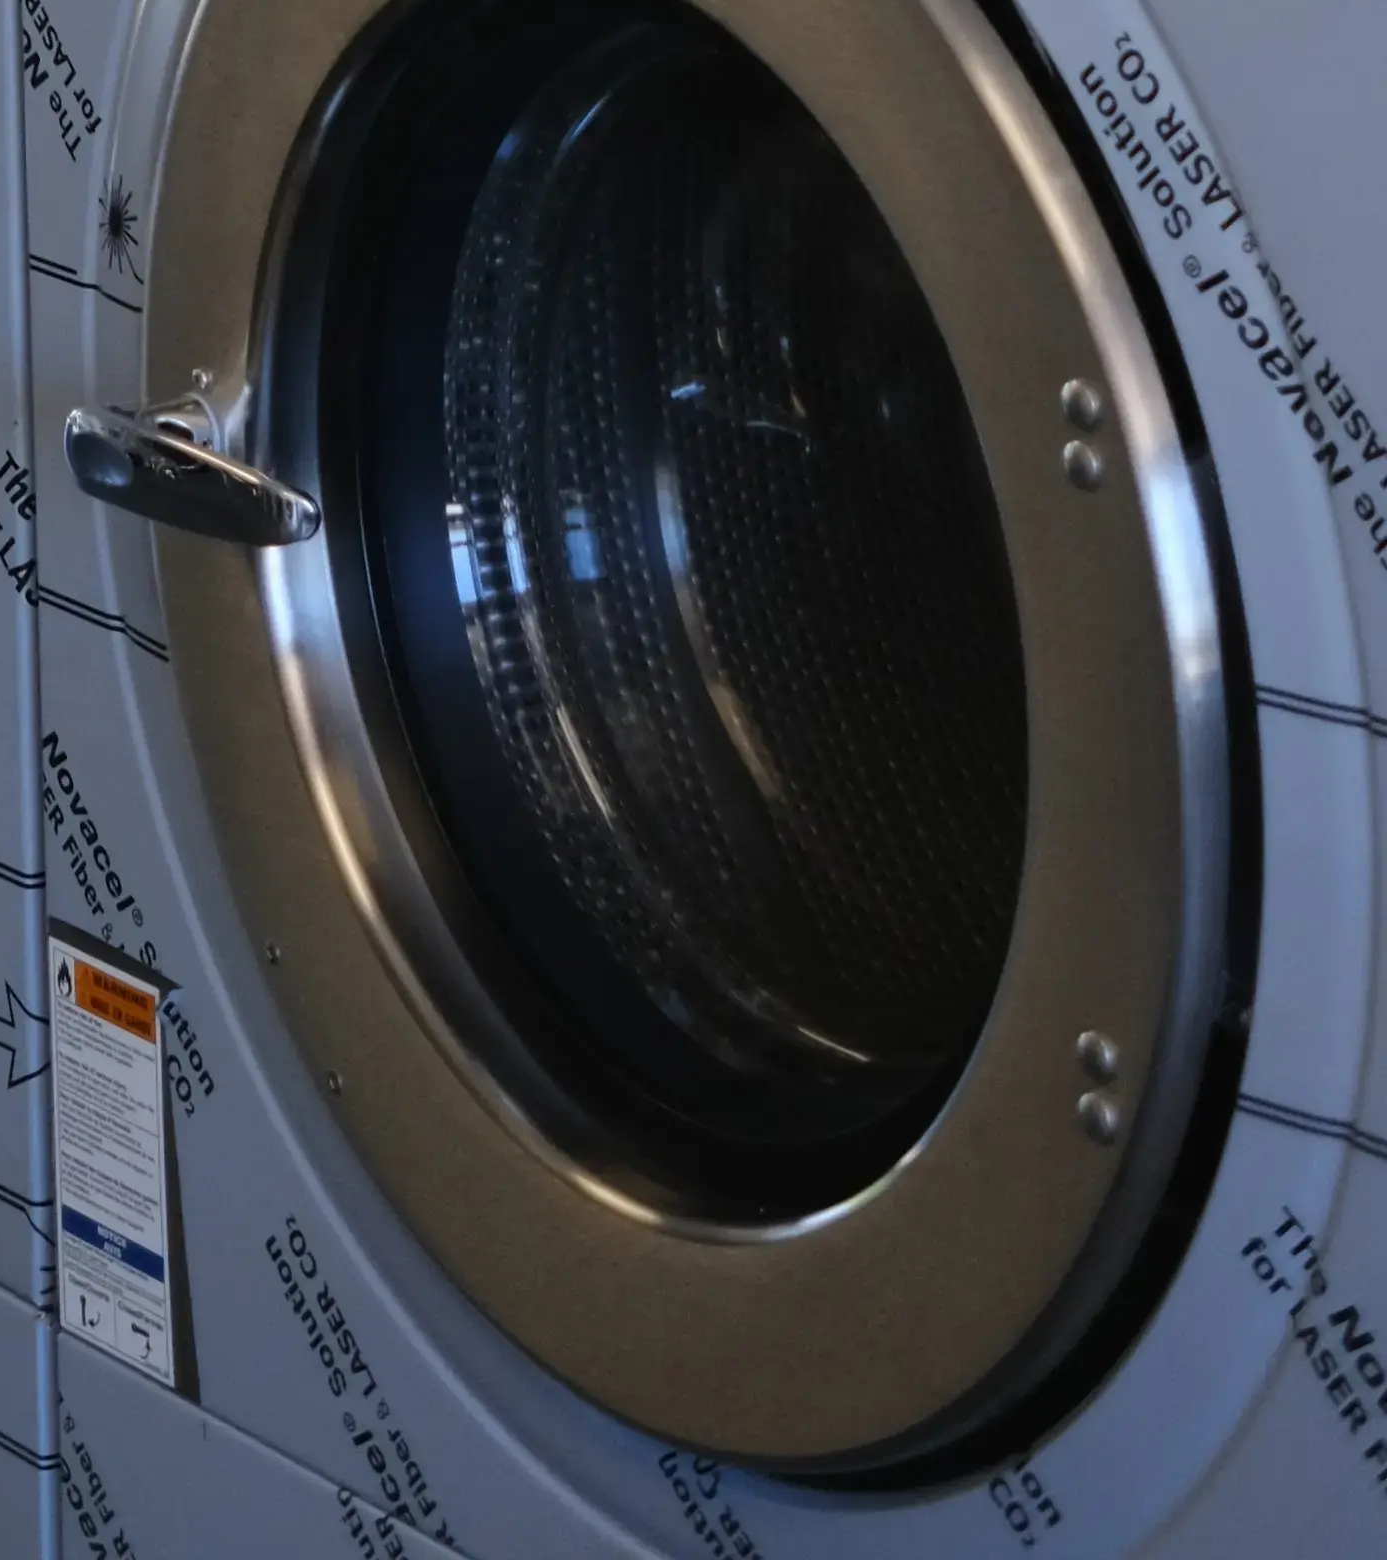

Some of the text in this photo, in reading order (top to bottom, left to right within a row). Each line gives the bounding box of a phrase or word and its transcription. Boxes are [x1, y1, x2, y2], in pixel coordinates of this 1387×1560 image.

[49, 90, 84, 163] The
[80, 86, 102, 136] for
[1079, 61, 1193, 241] Solution
[1153, 103, 1245, 233] LASER
[61, 832, 104, 918] Fiber
[1274, 1206, 1327, 1297] The
[266, 1235, 346, 1398] Solution
[315, 1279, 378, 1399] LASER
[1241, 1236, 1293, 1295] for
[1289, 1295, 1368, 1437] LASER
[71, 1439, 115, 1526] Fiber
[387, 1428, 437, 1517] Fiber
